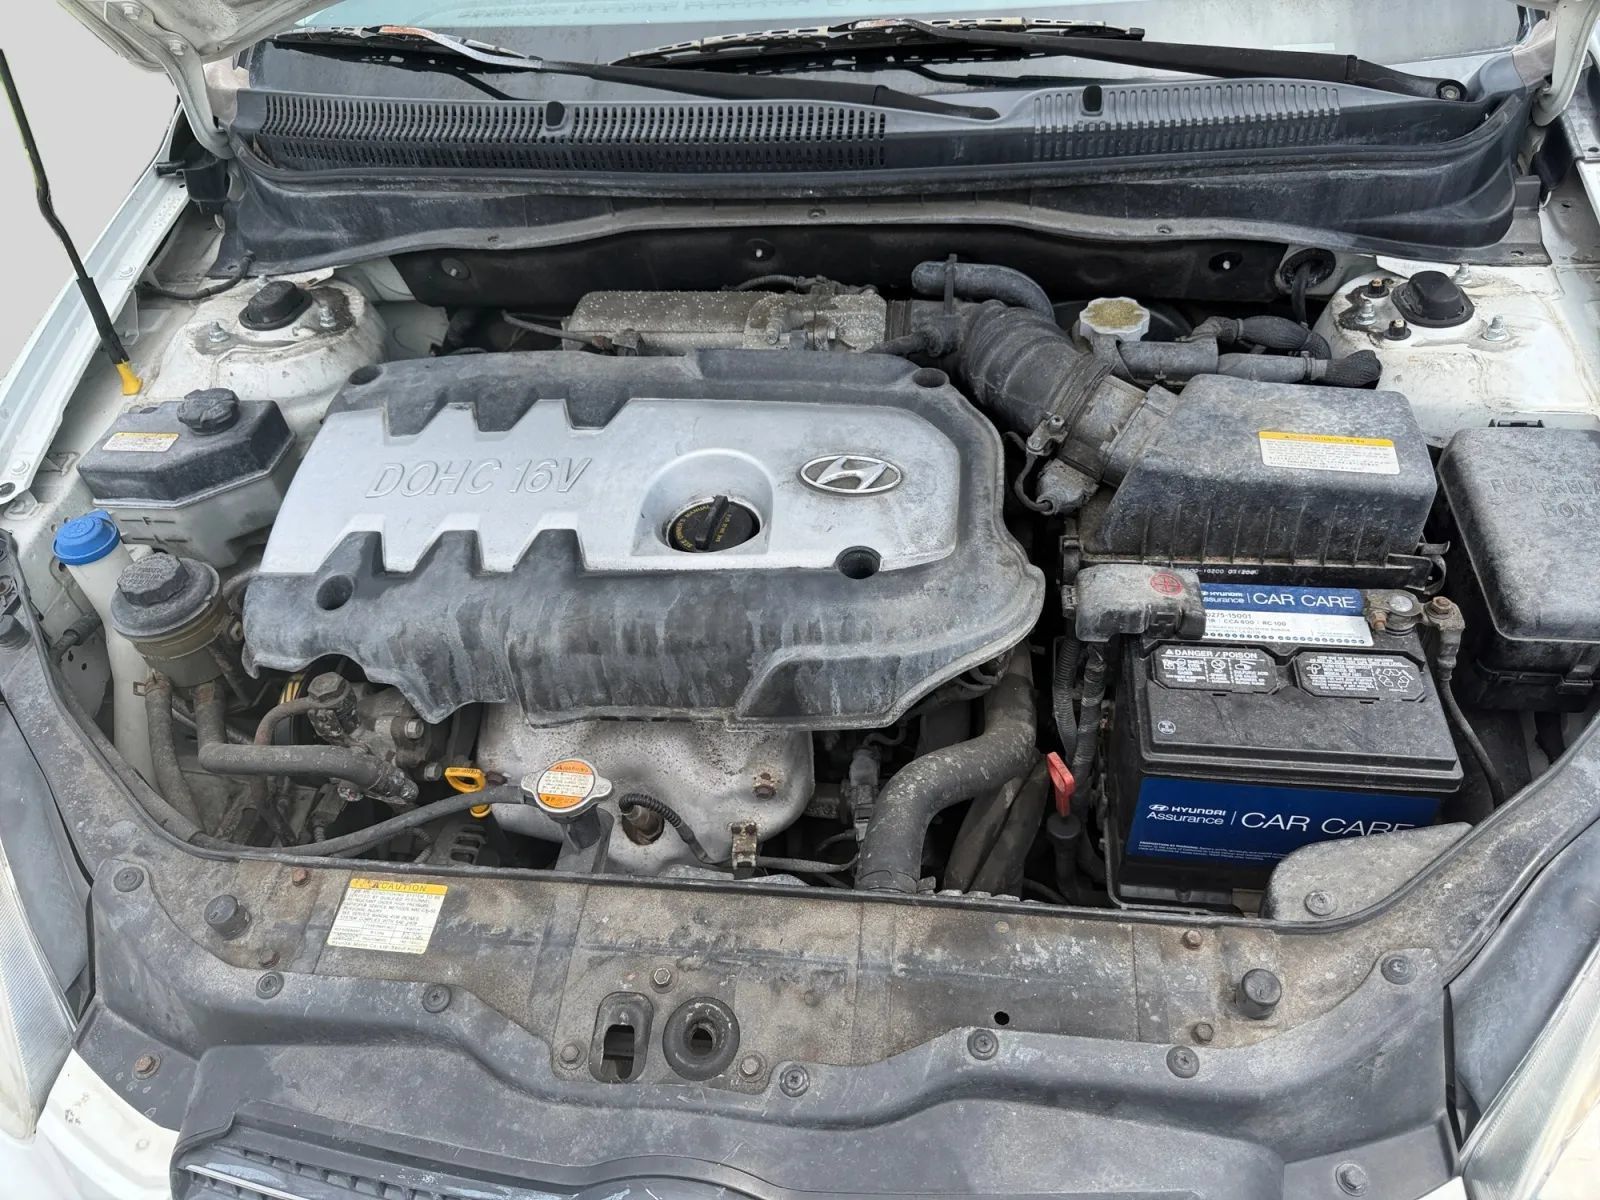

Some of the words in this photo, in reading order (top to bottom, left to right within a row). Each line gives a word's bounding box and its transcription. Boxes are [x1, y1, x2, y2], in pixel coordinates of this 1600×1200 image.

[365, 458, 502, 498] DOHC
[509, 458, 593, 494] 16V
[1252, 592, 1296, 606] CAR
[1300, 594, 1356, 609] CARE
[1174, 649, 1213, 658] DANGER
[1222, 651, 1258, 660] POISON
[1146, 811, 1225, 826] Assurance
[1171, 805, 1227, 817] HYUNDAI
[1240, 811, 1311, 833] CAR
[381, 881, 428, 892] CAUTION
